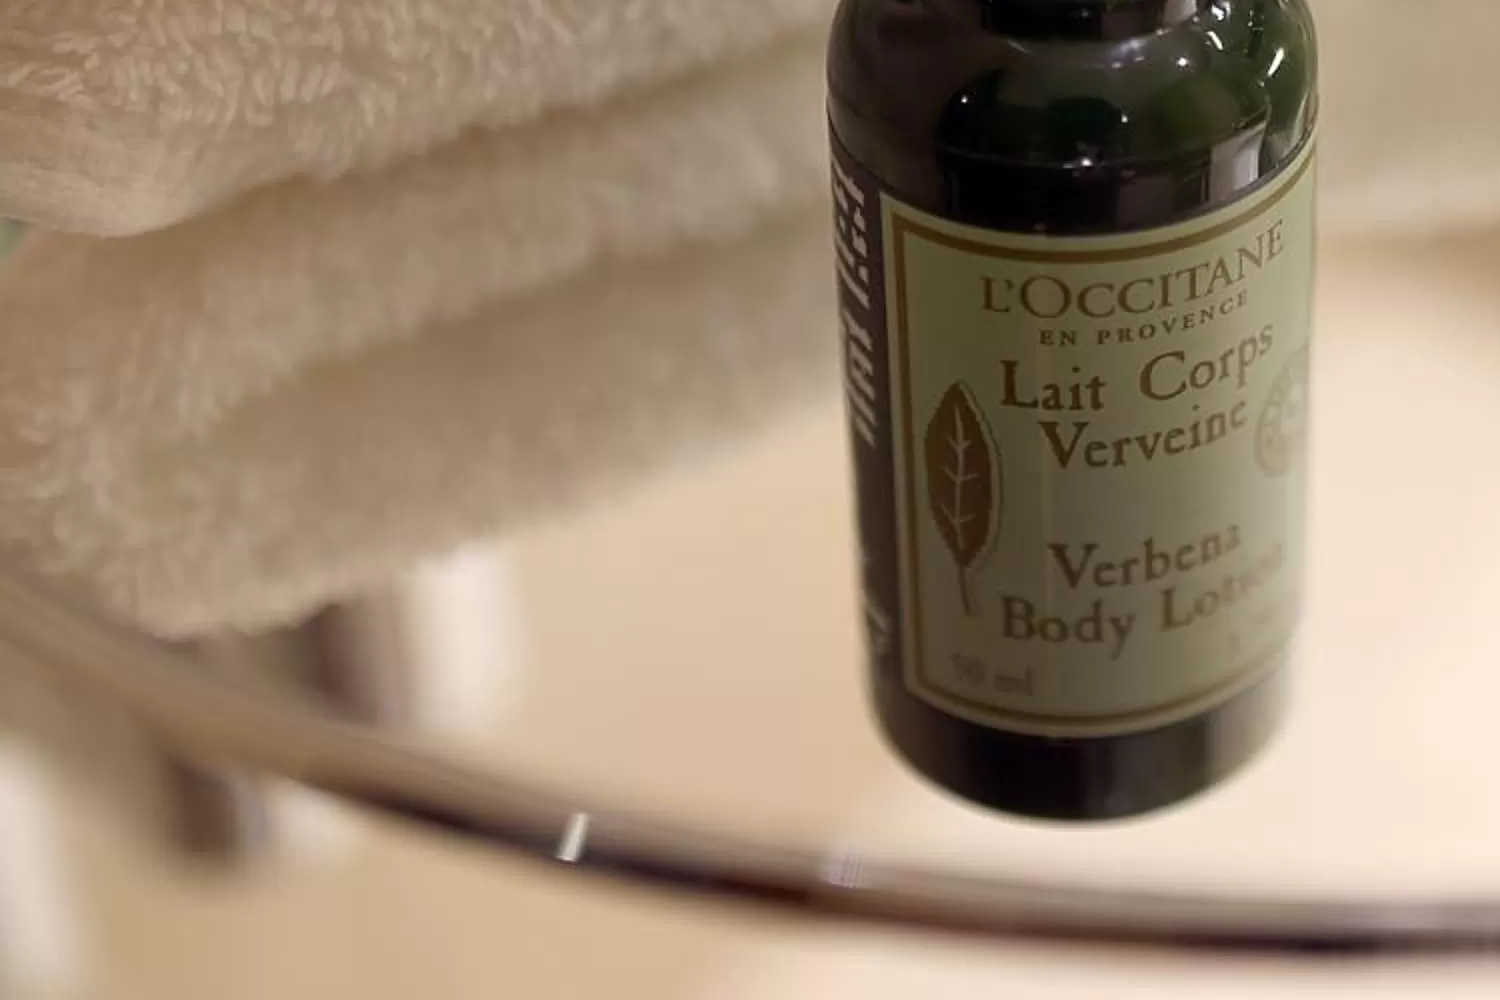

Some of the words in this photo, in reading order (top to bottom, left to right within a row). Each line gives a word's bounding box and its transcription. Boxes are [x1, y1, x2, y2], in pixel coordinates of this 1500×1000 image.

[980, 219, 1285, 320] L'OCCITANE
[1039, 329, 1077, 346] EN
[1098, 288, 1249, 345] PROVENCE
[1001, 360, 1105, 412] Lait
[1139, 323, 1274, 401] Corps
[1038, 399, 1247, 469] Verveine
[1048, 525, 1242, 589] Verbena
[1002, 596, 1136, 661] Body
[1159, 541, 1285, 633] Lot
